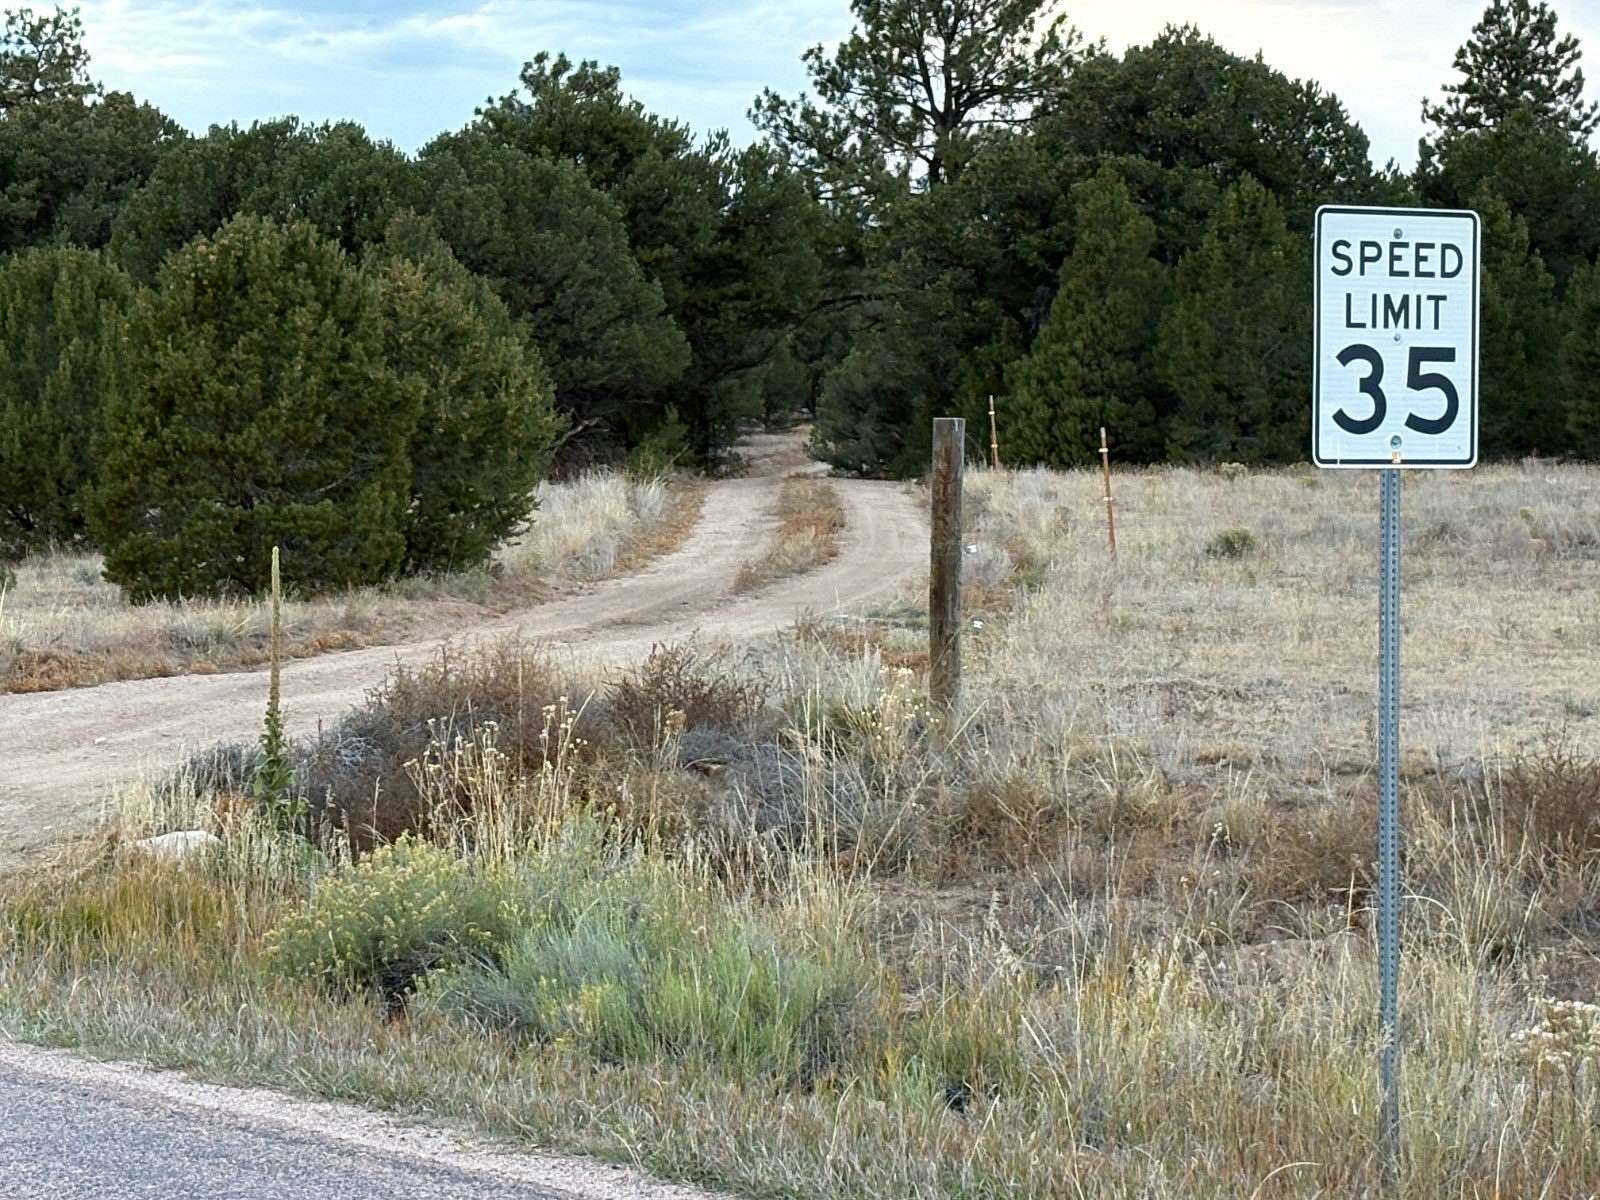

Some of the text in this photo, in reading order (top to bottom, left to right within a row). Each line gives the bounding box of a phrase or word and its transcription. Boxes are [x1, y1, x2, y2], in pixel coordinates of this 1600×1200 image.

[1331, 240, 1463, 279] SPEED
[1346, 292, 1448, 330] LIMIT
[1332, 343, 1459, 435] 35
